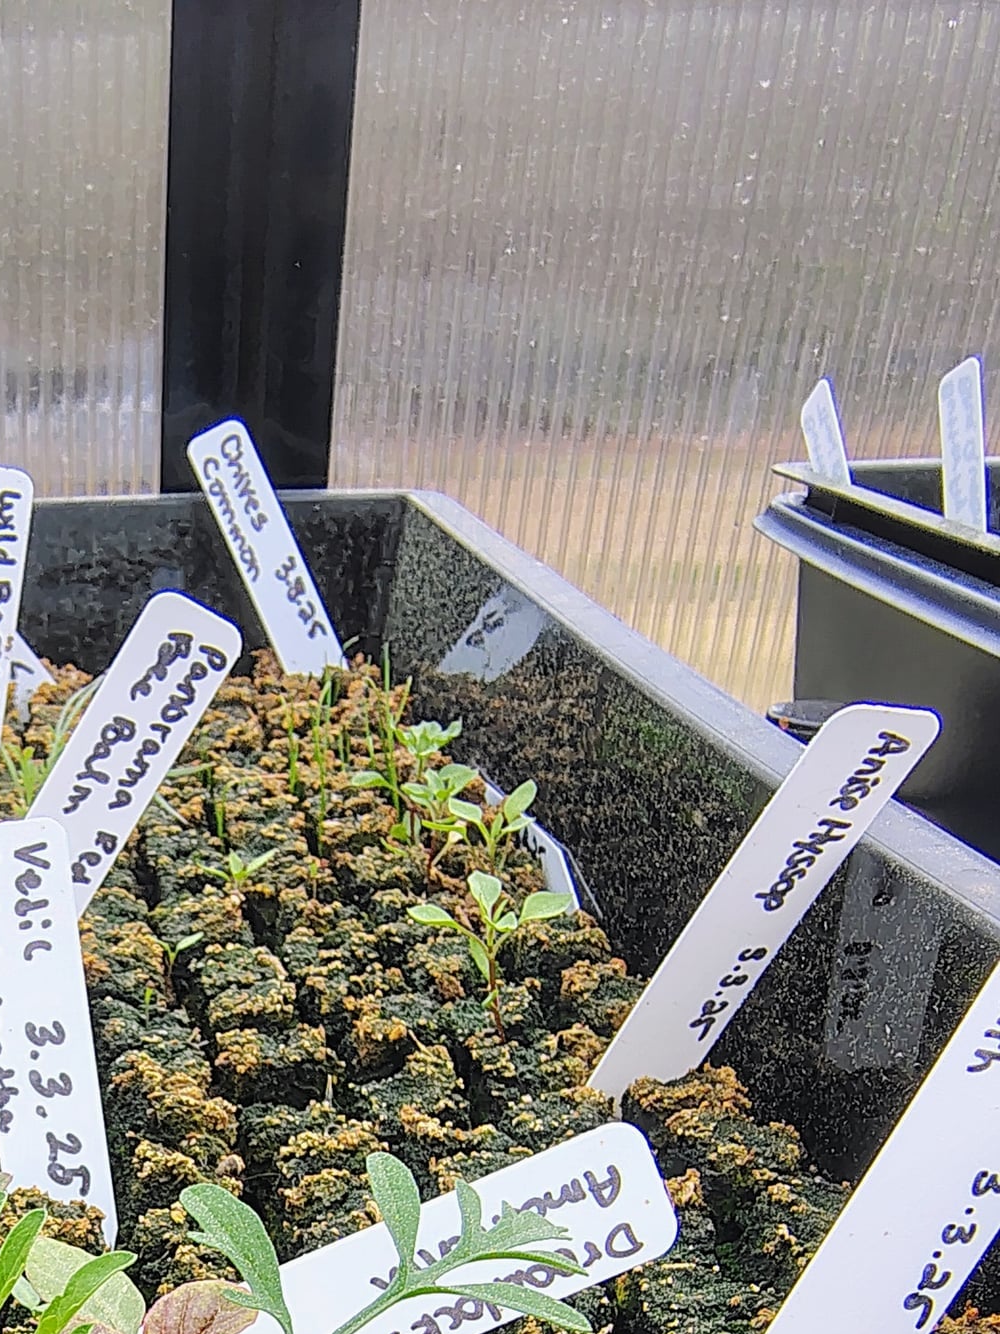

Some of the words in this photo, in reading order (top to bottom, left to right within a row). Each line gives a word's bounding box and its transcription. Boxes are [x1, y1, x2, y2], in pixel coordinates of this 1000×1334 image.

[203, 457, 261, 582] Common
[130, 632, 194, 700] Bee
[63, 716, 136, 814] Balm
[109, 643, 227, 810] Panorama
[829, 731, 911, 811] Anise
[14, 842, 53, 962] Vedic
[25, 1021, 91, 1196] 3.3.25
